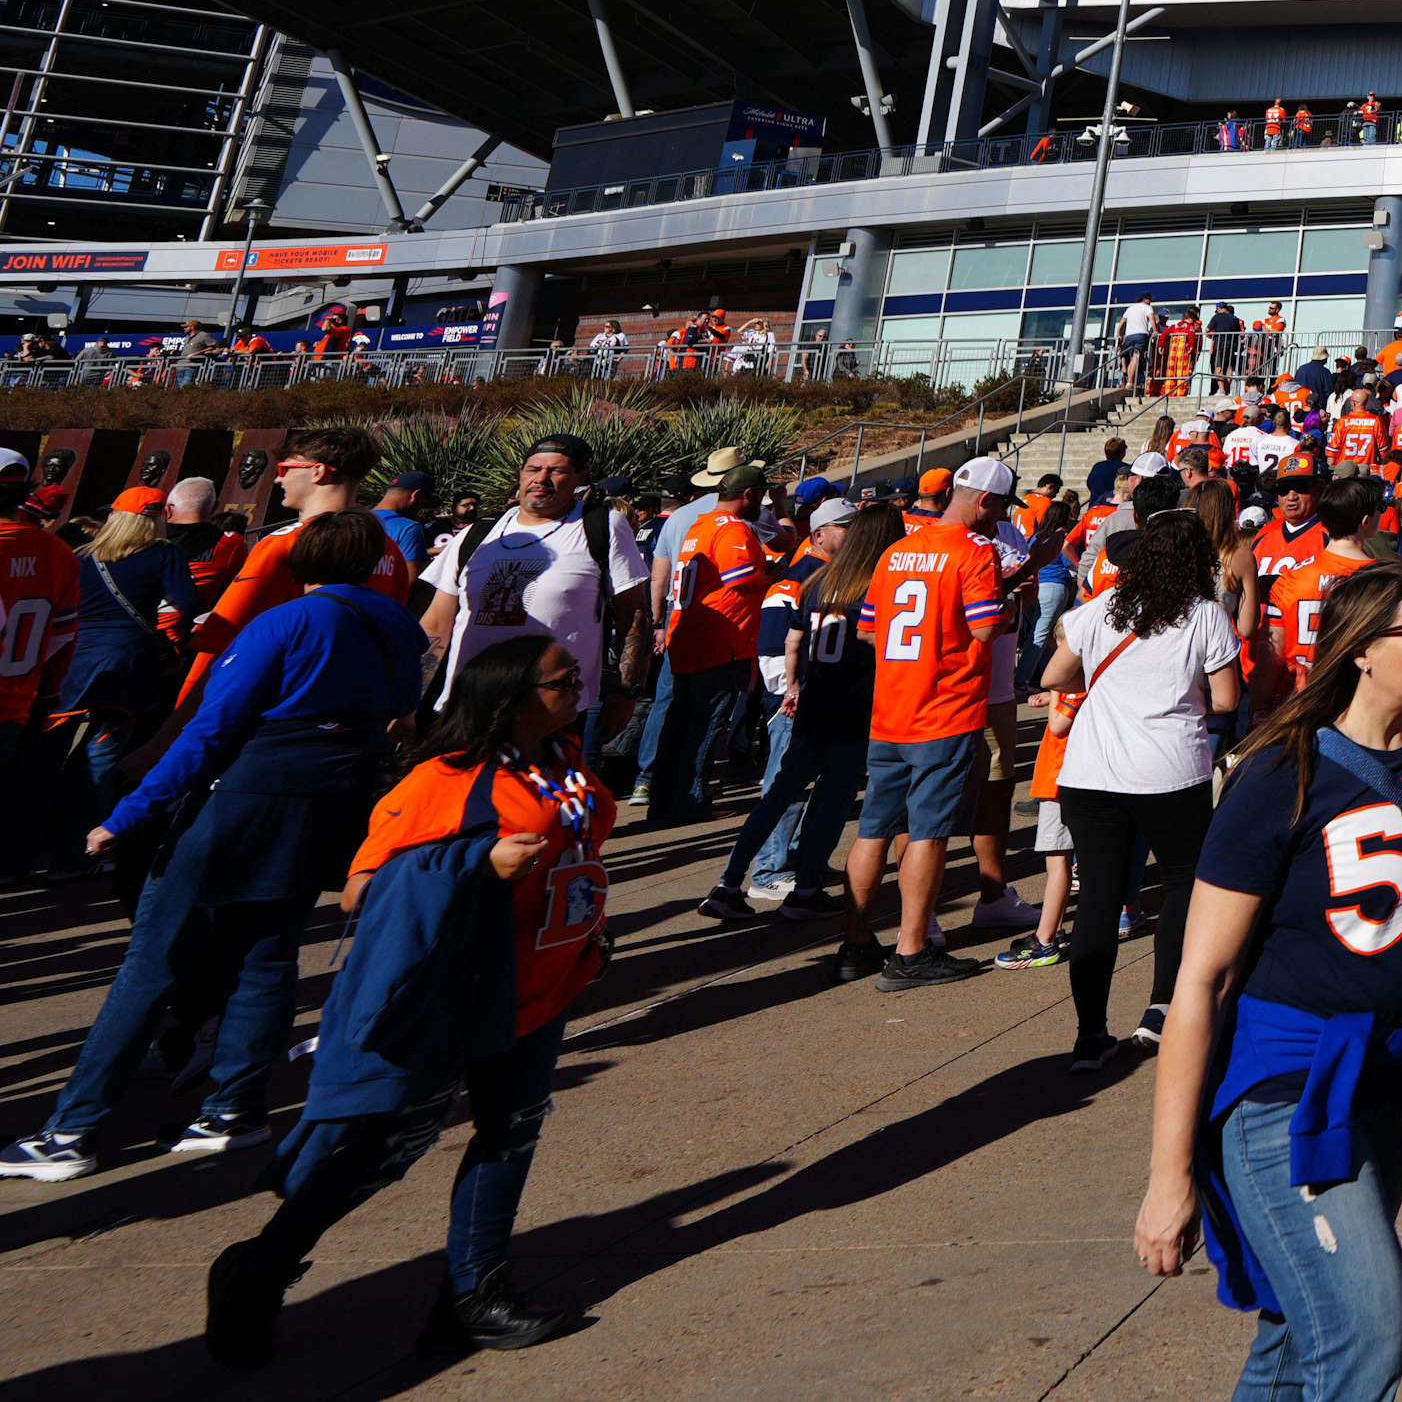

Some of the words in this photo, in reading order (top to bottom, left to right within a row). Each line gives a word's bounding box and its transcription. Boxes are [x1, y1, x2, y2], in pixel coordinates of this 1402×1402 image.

[784, 114, 815, 127] ULTRA
[2, 255, 47, 270] JOIN
[51, 255, 92, 269] WIFI
[391, 333, 416, 341] WELCOME
[442, 334, 461, 343] FIELD
[444, 325, 479, 335] EMPOWER
[1345, 433, 1373, 457] 57
[10, 556, 37, 578] NIX
[888, 551, 936, 573] SURTAIN
[884, 578, 928, 662] 2
[0, 598, 52, 678] 0
[808, 611, 848, 664] 10
